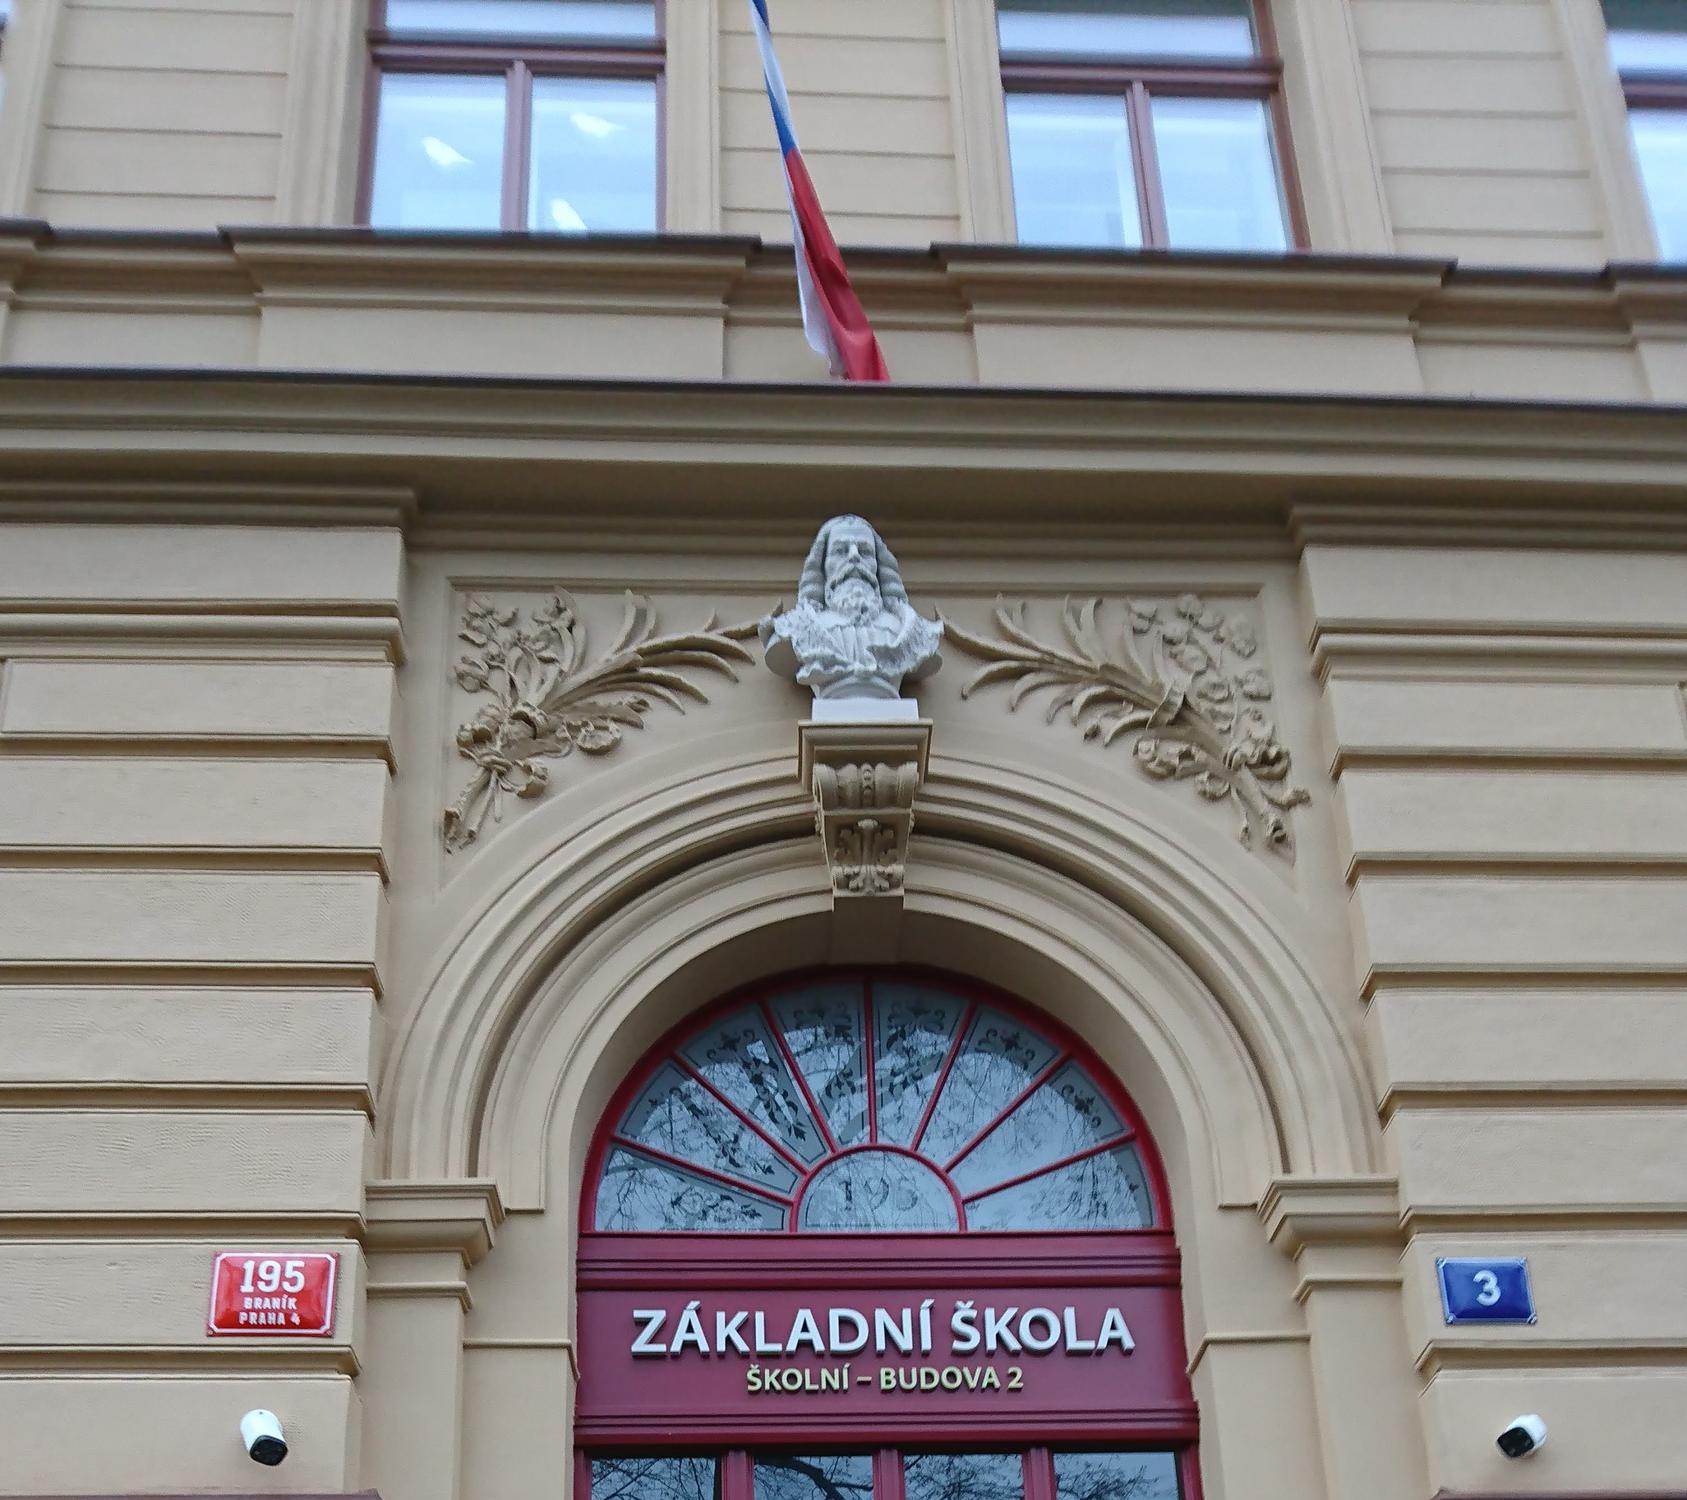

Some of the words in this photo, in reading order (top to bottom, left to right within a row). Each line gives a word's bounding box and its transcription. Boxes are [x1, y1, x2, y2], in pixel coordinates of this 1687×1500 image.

[240, 1260, 305, 1293] 195
[1473, 1270, 1501, 1306] 3
[243, 1294, 297, 1310] BRANÍK
[239, 1312, 286, 1325] PRAHA
[291, 1311, 300, 1325] 4
[631, 1299, 936, 1356] ZÁKLADNÍ
[951, 1300, 1135, 1356] ŠKOLA
[746, 1364, 851, 1392] ŠKOLNÍ
[879, 1365, 1001, 1391] BUDOVA
[1008, 1365, 1024, 1389] 2
